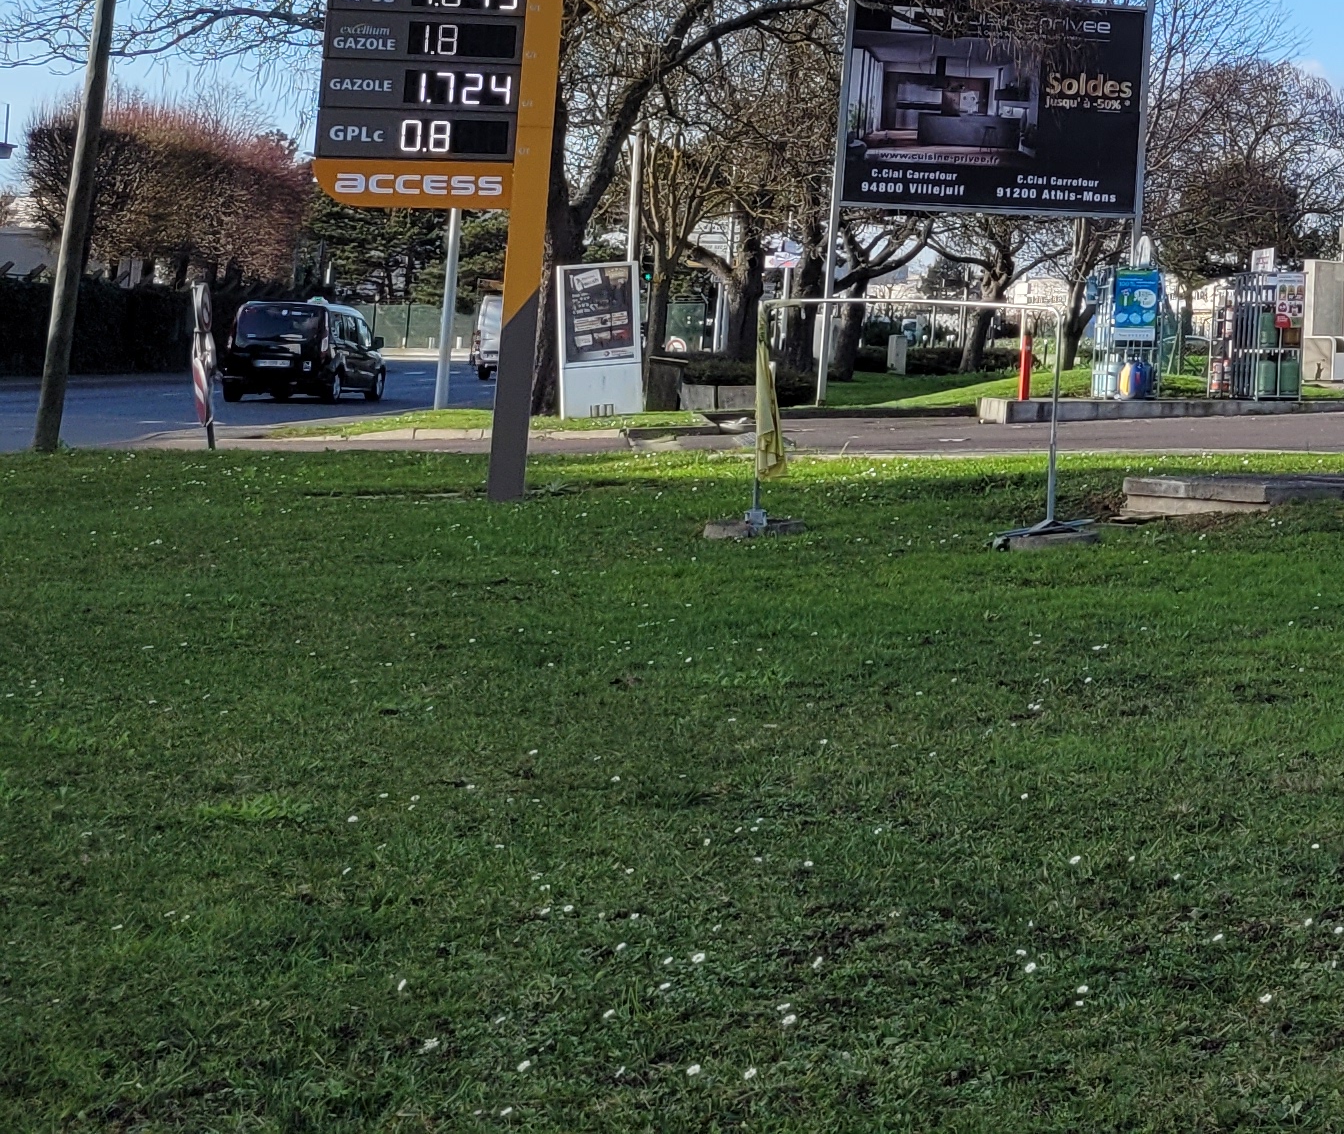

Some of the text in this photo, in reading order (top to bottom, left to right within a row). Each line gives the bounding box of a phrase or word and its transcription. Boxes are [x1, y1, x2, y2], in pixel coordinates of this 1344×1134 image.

[340, 24, 390, 36] excellium
[333, 36, 396, 51] GAZOLE
[330, 78, 393, 92] GAZOLE
[420, 72, 511, 105] 1.724
[1045, 72, 1132, 97] Soldes
[329, 125, 385, 142] GPLc
[906, 170, 957, 181] Carrefour
[1050, 177, 1099, 187] Carrefour
[861, 182, 965, 197] 94800 Villejuif
[996, 187, 1117, 202] 91200 Athis-Mons
